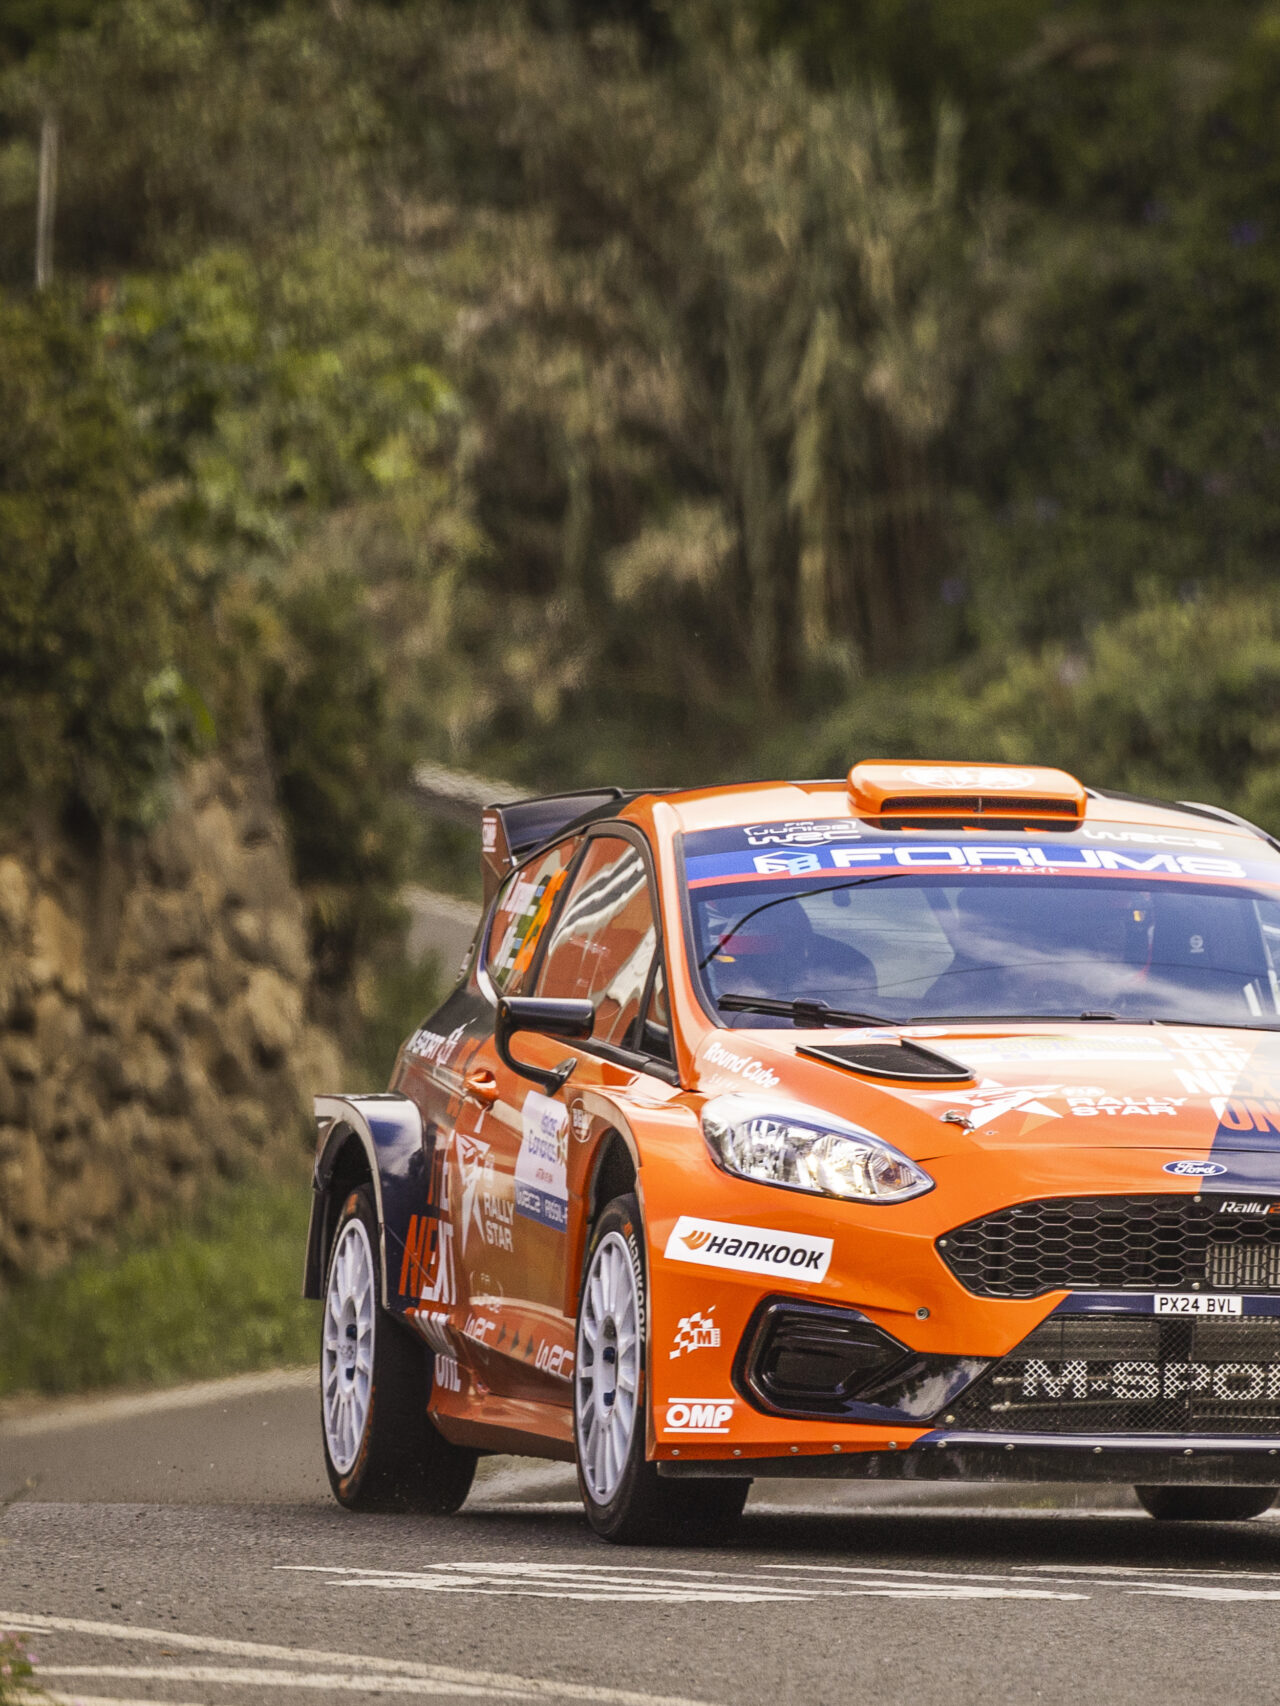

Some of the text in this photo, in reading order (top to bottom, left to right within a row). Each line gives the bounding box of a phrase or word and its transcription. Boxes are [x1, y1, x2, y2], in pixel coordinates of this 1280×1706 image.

[748, 830, 862, 846] WRC
[830, 846, 1247, 879] FORUM8
[703, 1042, 752, 1073] Round
[741, 1061, 780, 1088] Cube
[1066, 1096, 1189, 1107] RALLY
[1071, 1105, 1178, 1117] STAR
[1174, 1162, 1217, 1174] Ford
[483, 1191, 515, 1226] RALLY
[485, 1219, 514, 1253] STAR
[1159, 1297, 1236, 1313] PX24 BVL
[666, 1404, 733, 1428] OMP
